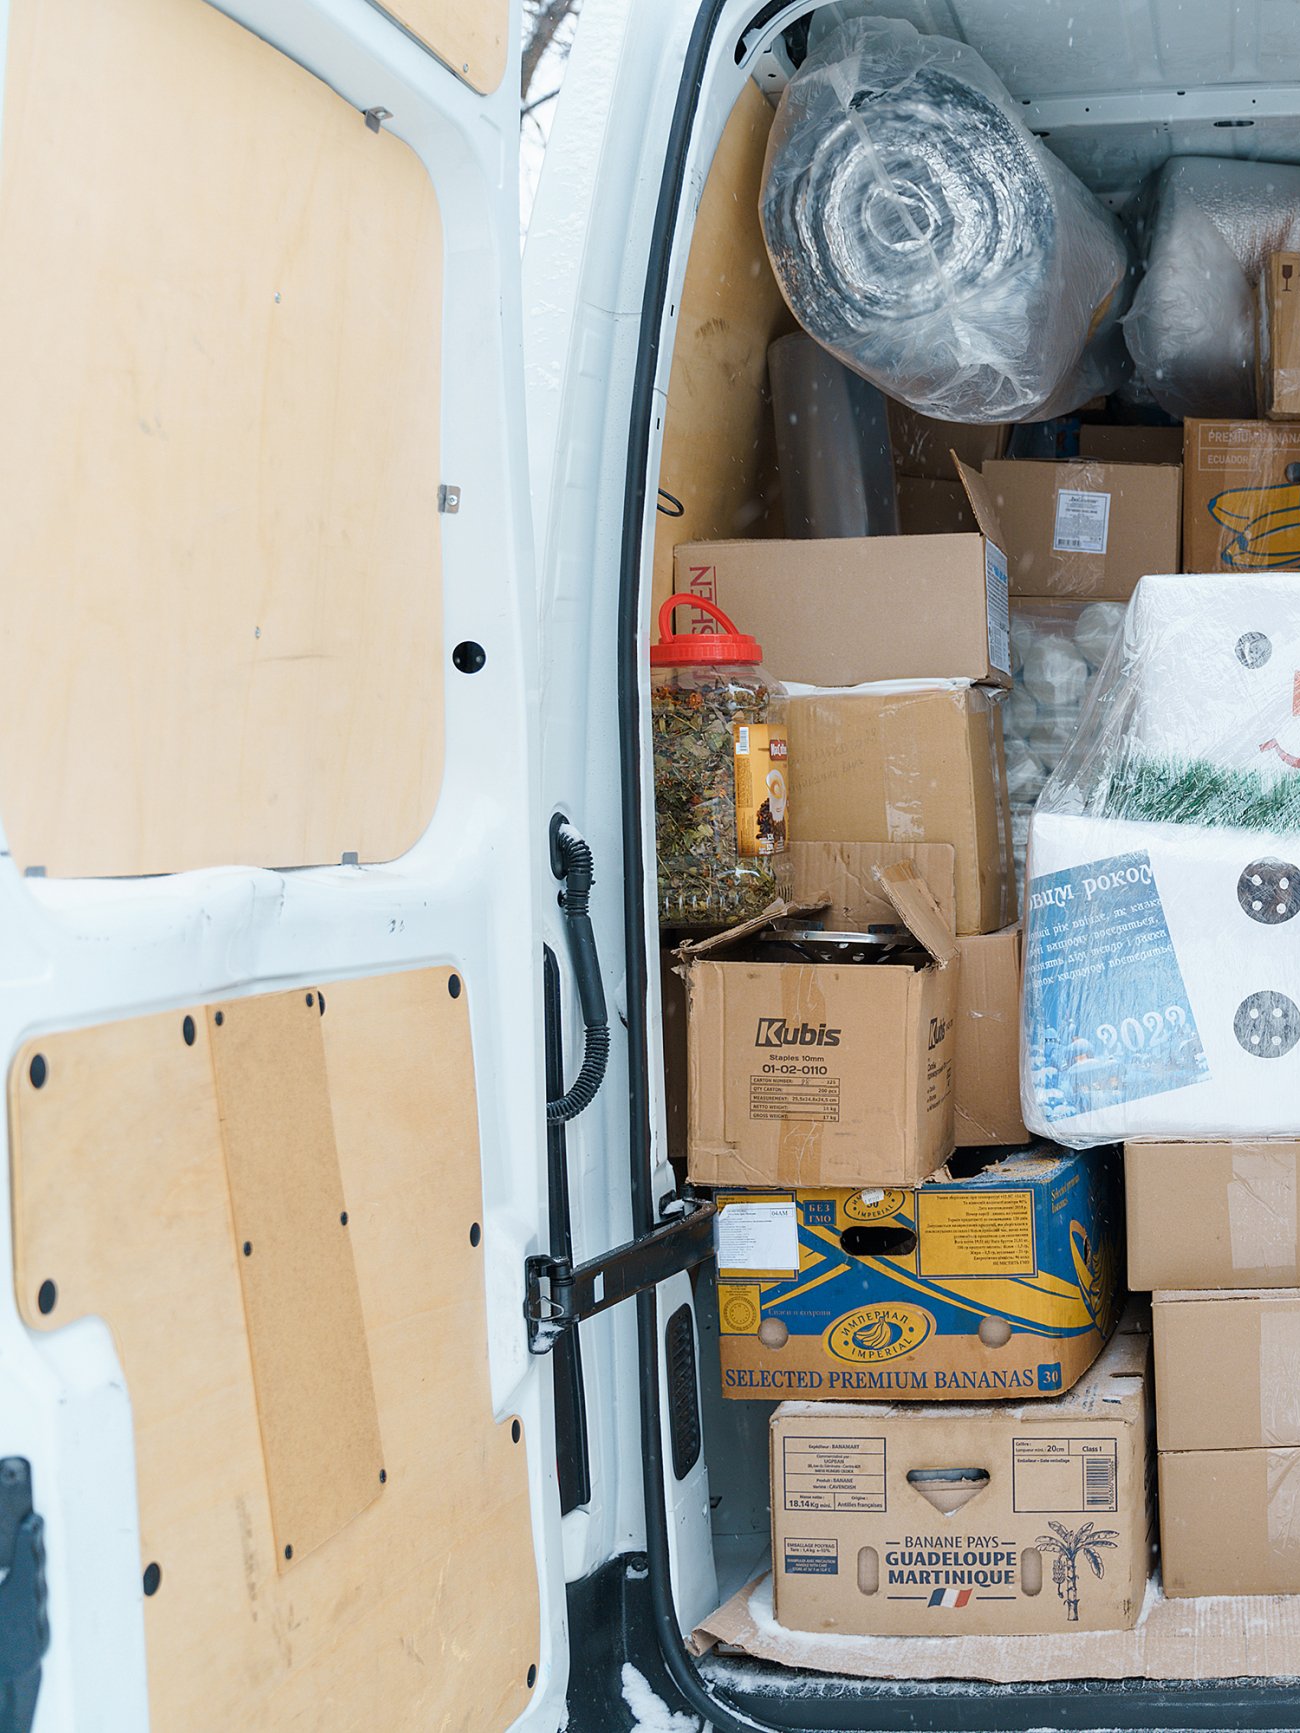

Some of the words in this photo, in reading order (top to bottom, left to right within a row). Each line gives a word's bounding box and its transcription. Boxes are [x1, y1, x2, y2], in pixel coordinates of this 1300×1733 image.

[1208, 431, 1256, 443] PREMIUM
[1207, 454, 1249, 464] ECUADOR
[754, 1017, 842, 1048] Kubis
[769, 1054, 800, 1062] Staples
[762, 1064, 828, 1075] 01-02-0110
[808, 1203, 831, 1213] БЕЗ
[857, 1204, 894, 1218] IMPERIAL
[808, 1215, 832, 1224] ГМО
[841, 1310, 909, 1337] ИМПЕРИАЛ
[851, 1337, 913, 1360] IMPERIAL
[725, 1369, 823, 1389] SELECTED
[828, 1371, 927, 1389] PREMIUM
[934, 1369, 1034, 1389] BANANAS
[1043, 1371, 1059, 1384] 30
[904, 1535, 963, 1549] BANANE
[967, 1535, 999, 1549] PAYS
[885, 1551, 1017, 1567] GUADELOUPE
[888, 1569, 1015, 1588] MARTINIQUE
